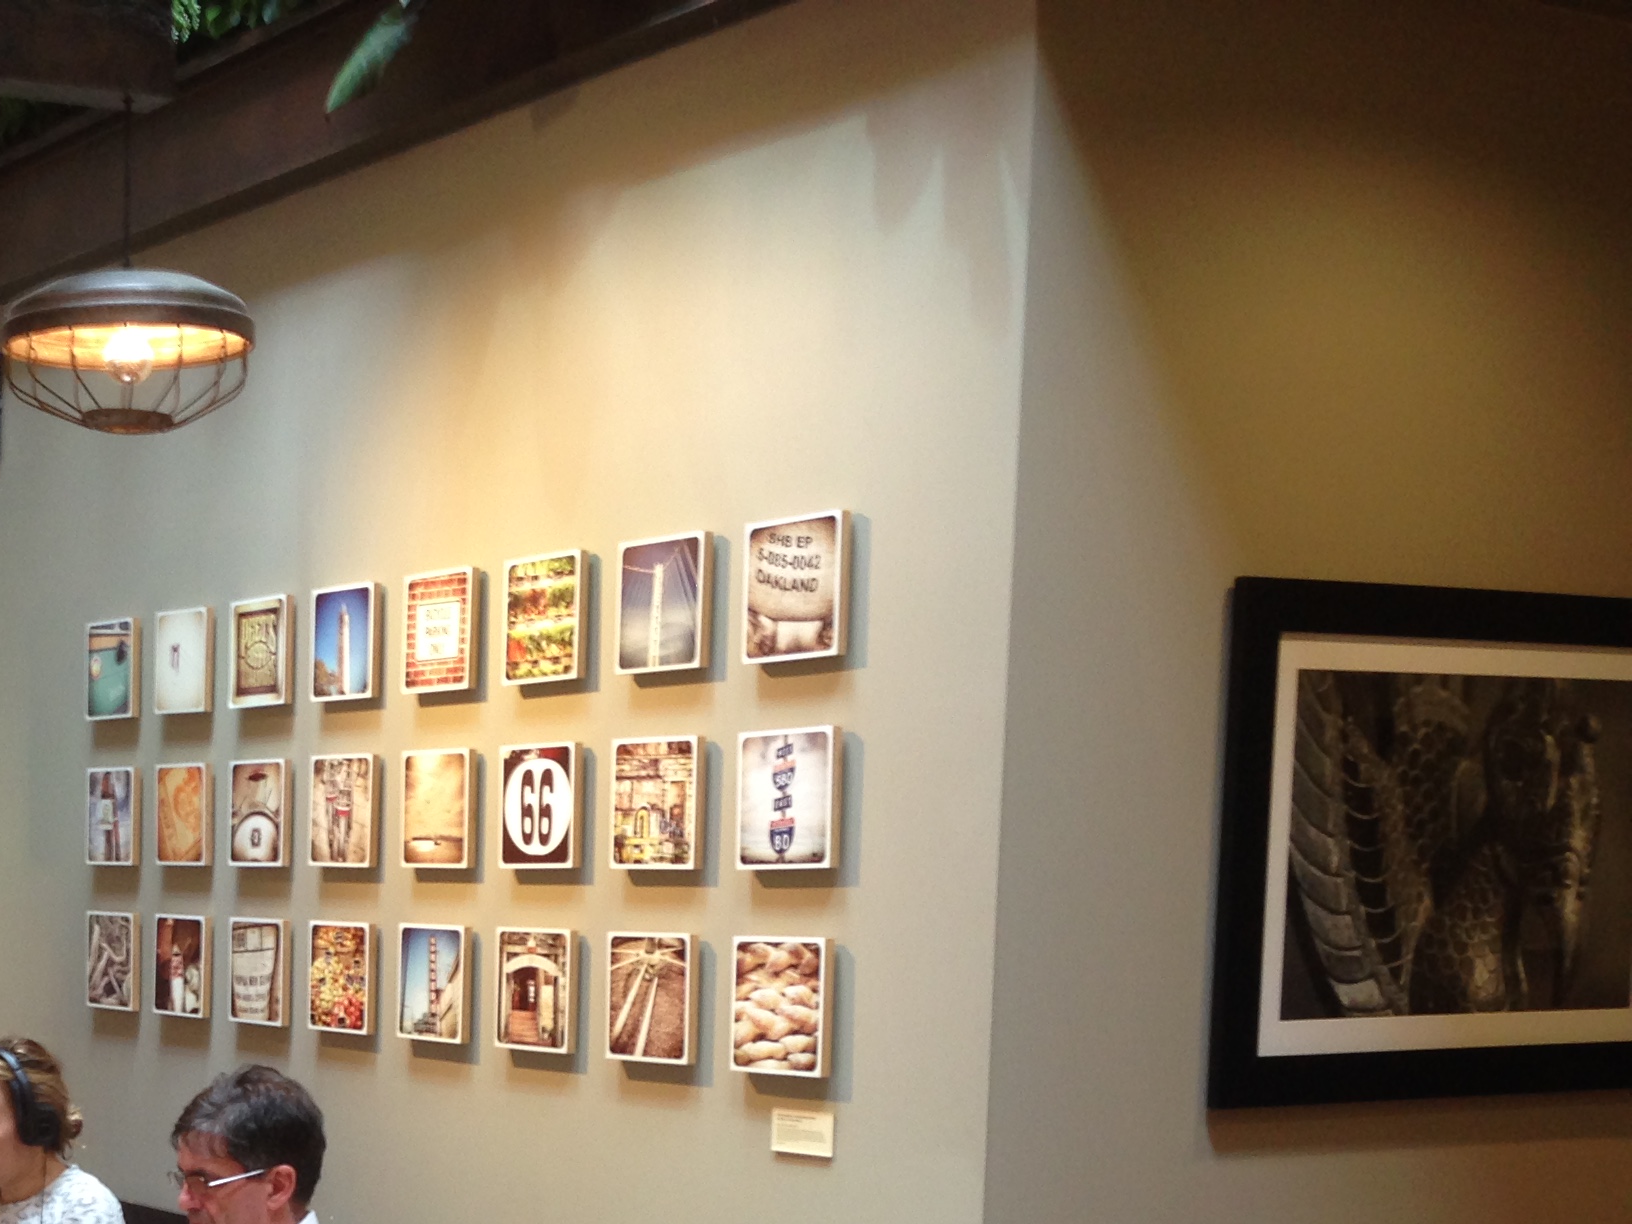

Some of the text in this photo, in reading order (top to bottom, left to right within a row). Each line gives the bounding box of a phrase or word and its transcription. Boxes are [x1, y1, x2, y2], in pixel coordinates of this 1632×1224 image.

[756, 568, 819, 593] OAKLAND
[520, 768, 555, 848] 66
[774, 834, 790, 851] 80
